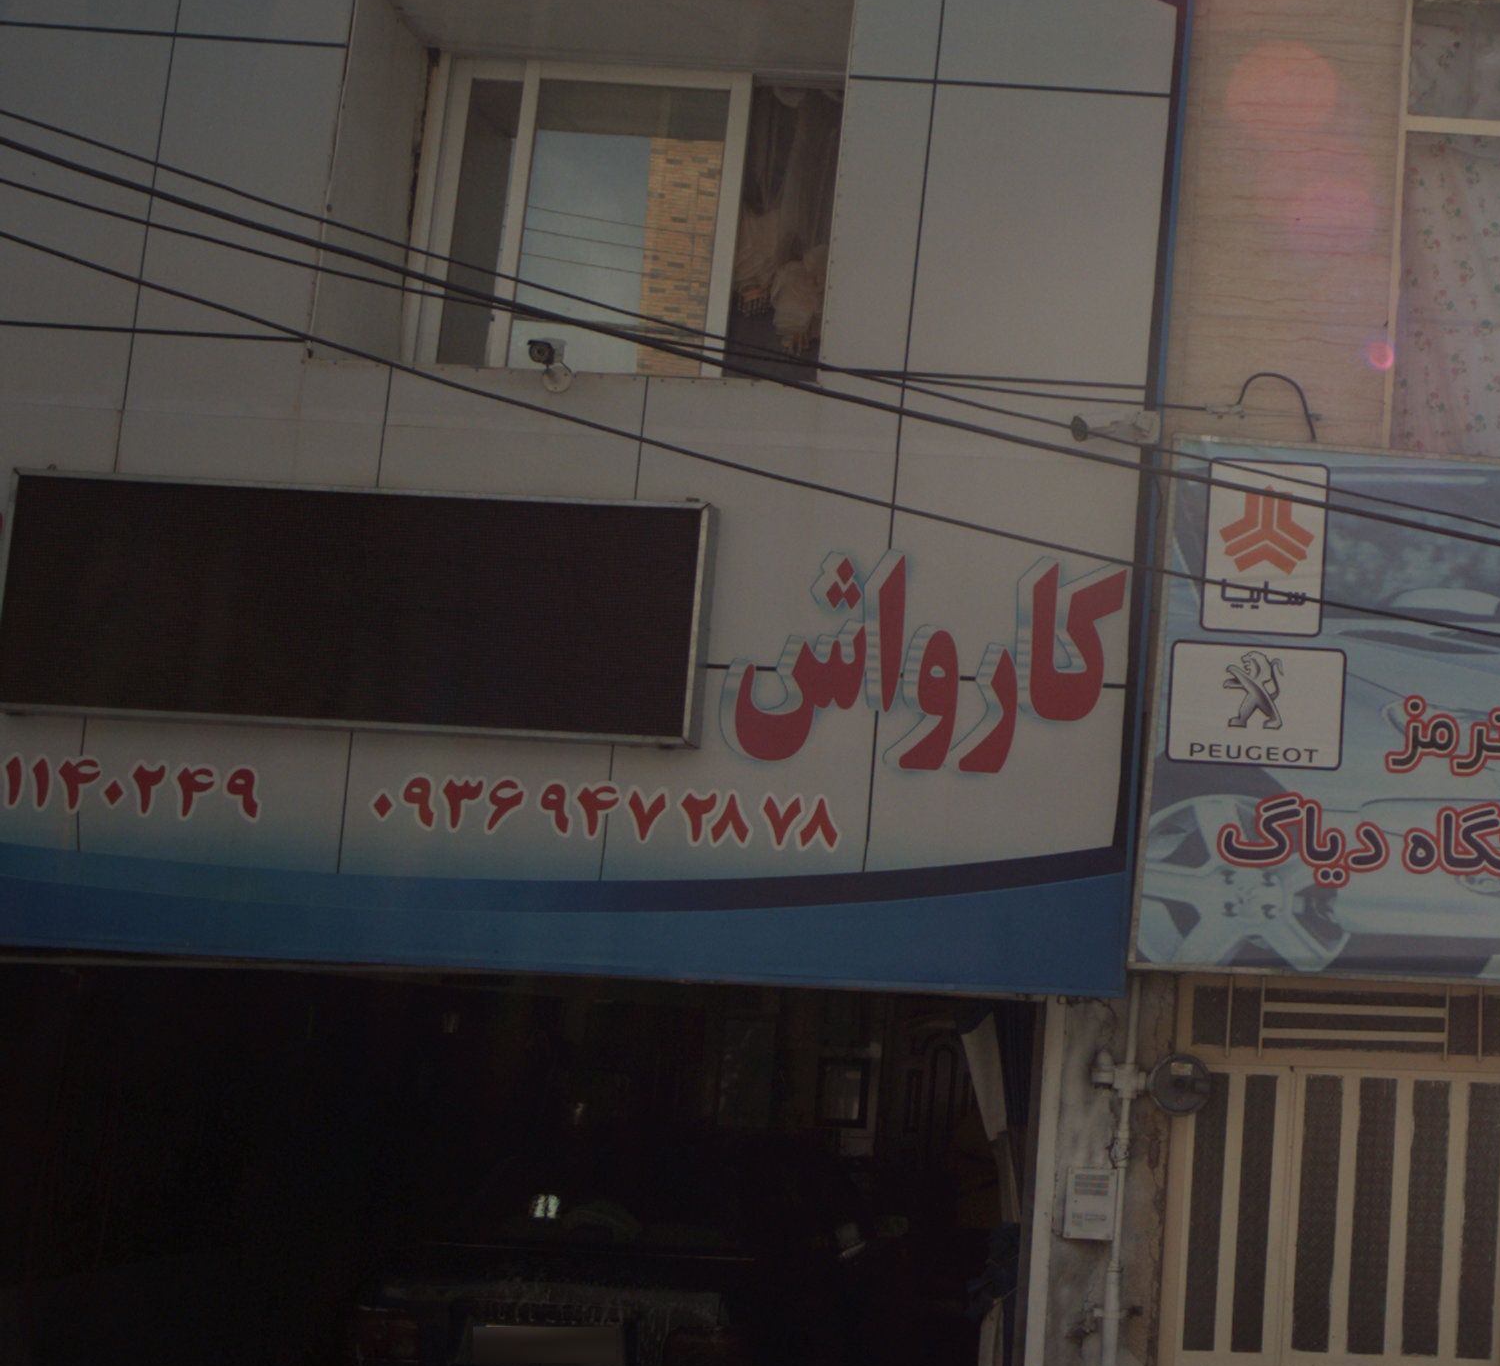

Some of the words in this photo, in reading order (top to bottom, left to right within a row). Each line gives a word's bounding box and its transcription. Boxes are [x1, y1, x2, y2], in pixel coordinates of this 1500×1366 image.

[735, 553, 1127, 773] کارواش
[1188, 741, 1320, 765] PEUGEOT
[1217, 792, 1390, 887] دیاگ
